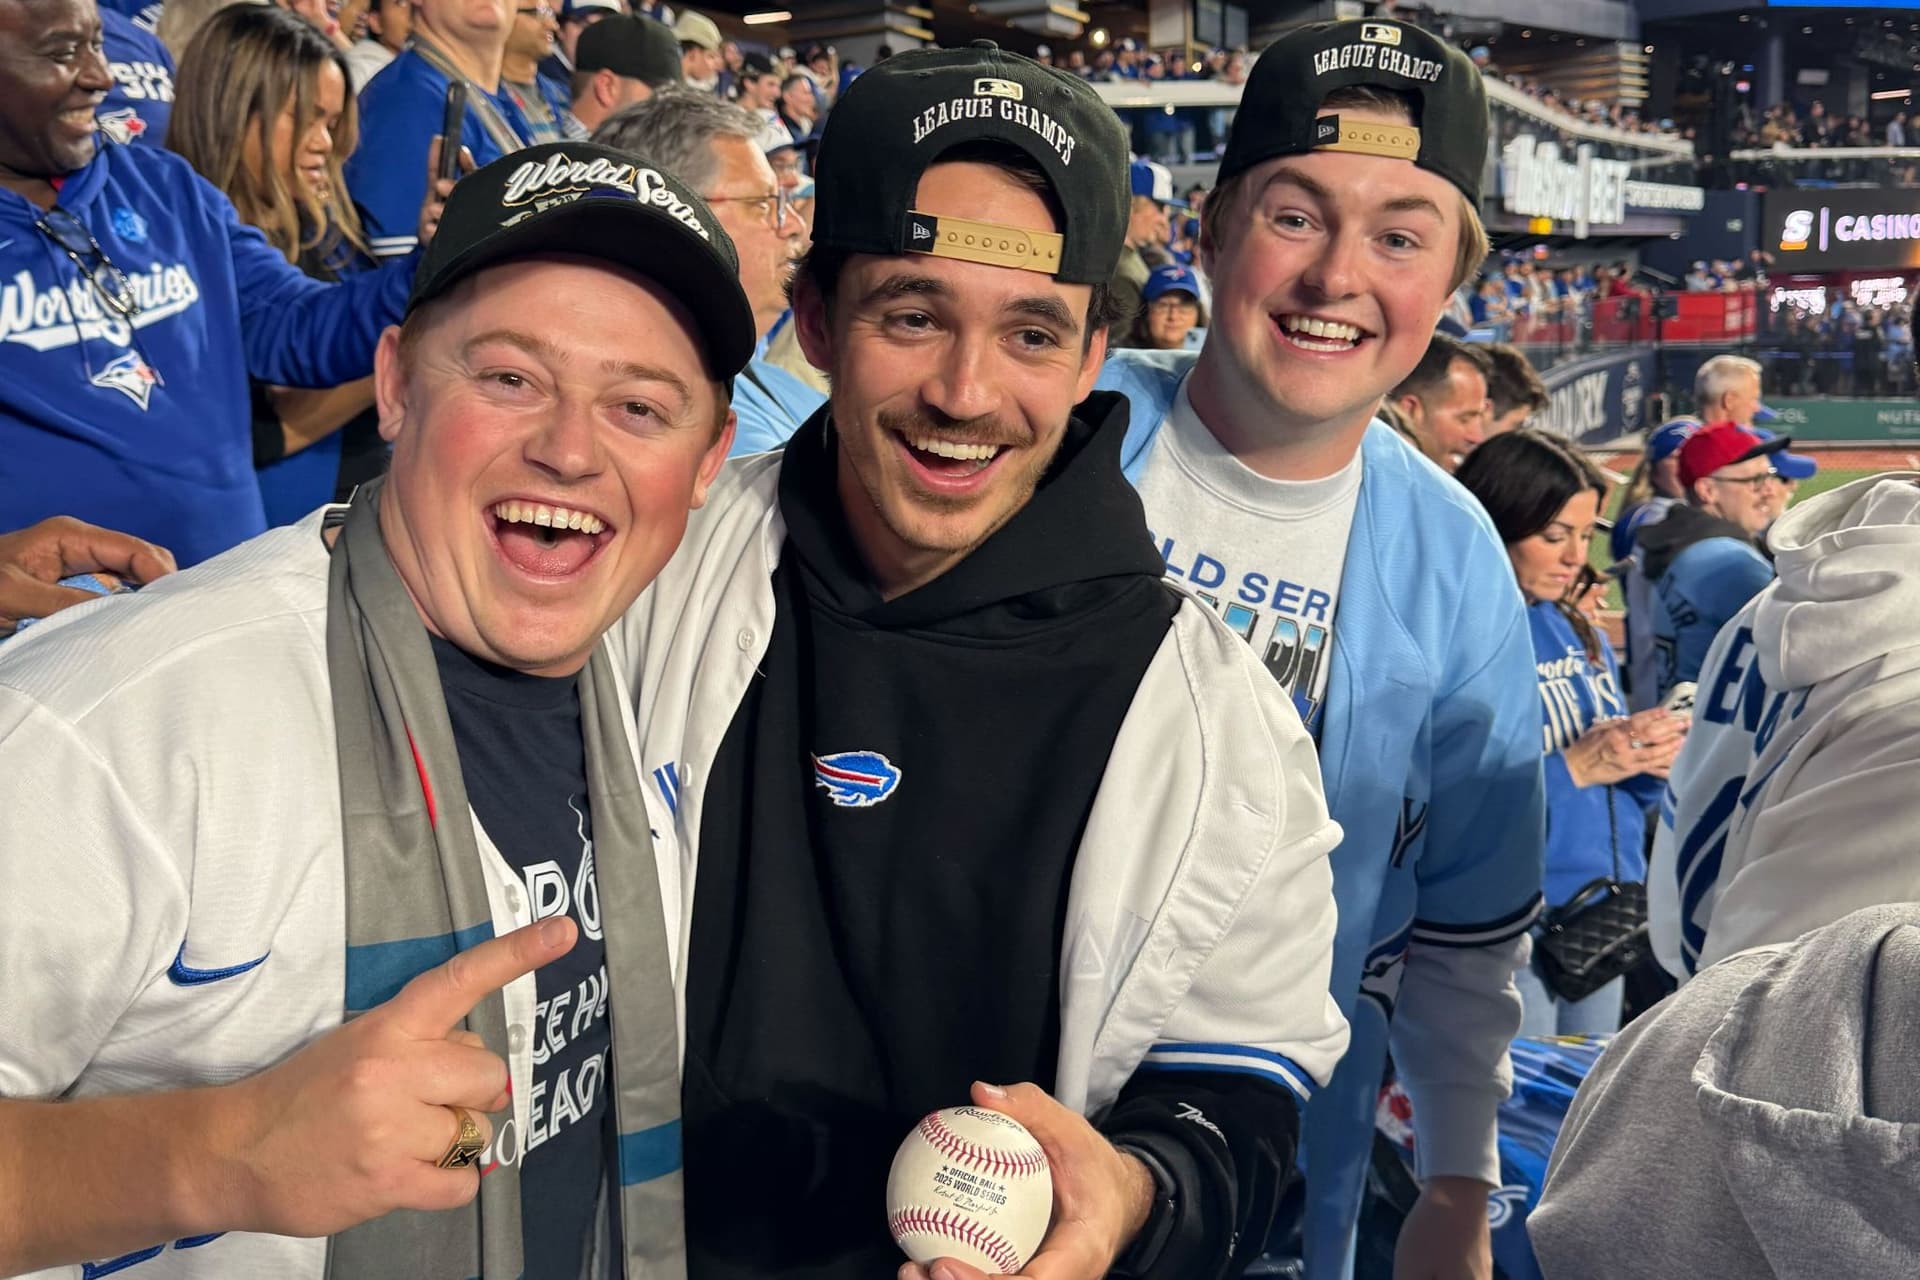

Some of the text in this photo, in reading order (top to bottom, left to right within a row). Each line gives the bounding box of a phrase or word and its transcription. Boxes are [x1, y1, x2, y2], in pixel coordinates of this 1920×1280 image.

[1313, 44, 1443, 82] LEAGUE CHAMPS
[912, 98, 1076, 166] LEAGUE CHAMPS
[502, 152, 710, 241] World Series
[1152, 533, 1226, 588] LD
[954, 1107, 1023, 1133] Rawlings
[934, 1171, 1008, 1206] 2025 WORLD SERIES
[949, 1167, 997, 1191] OFFICIAL BALL
